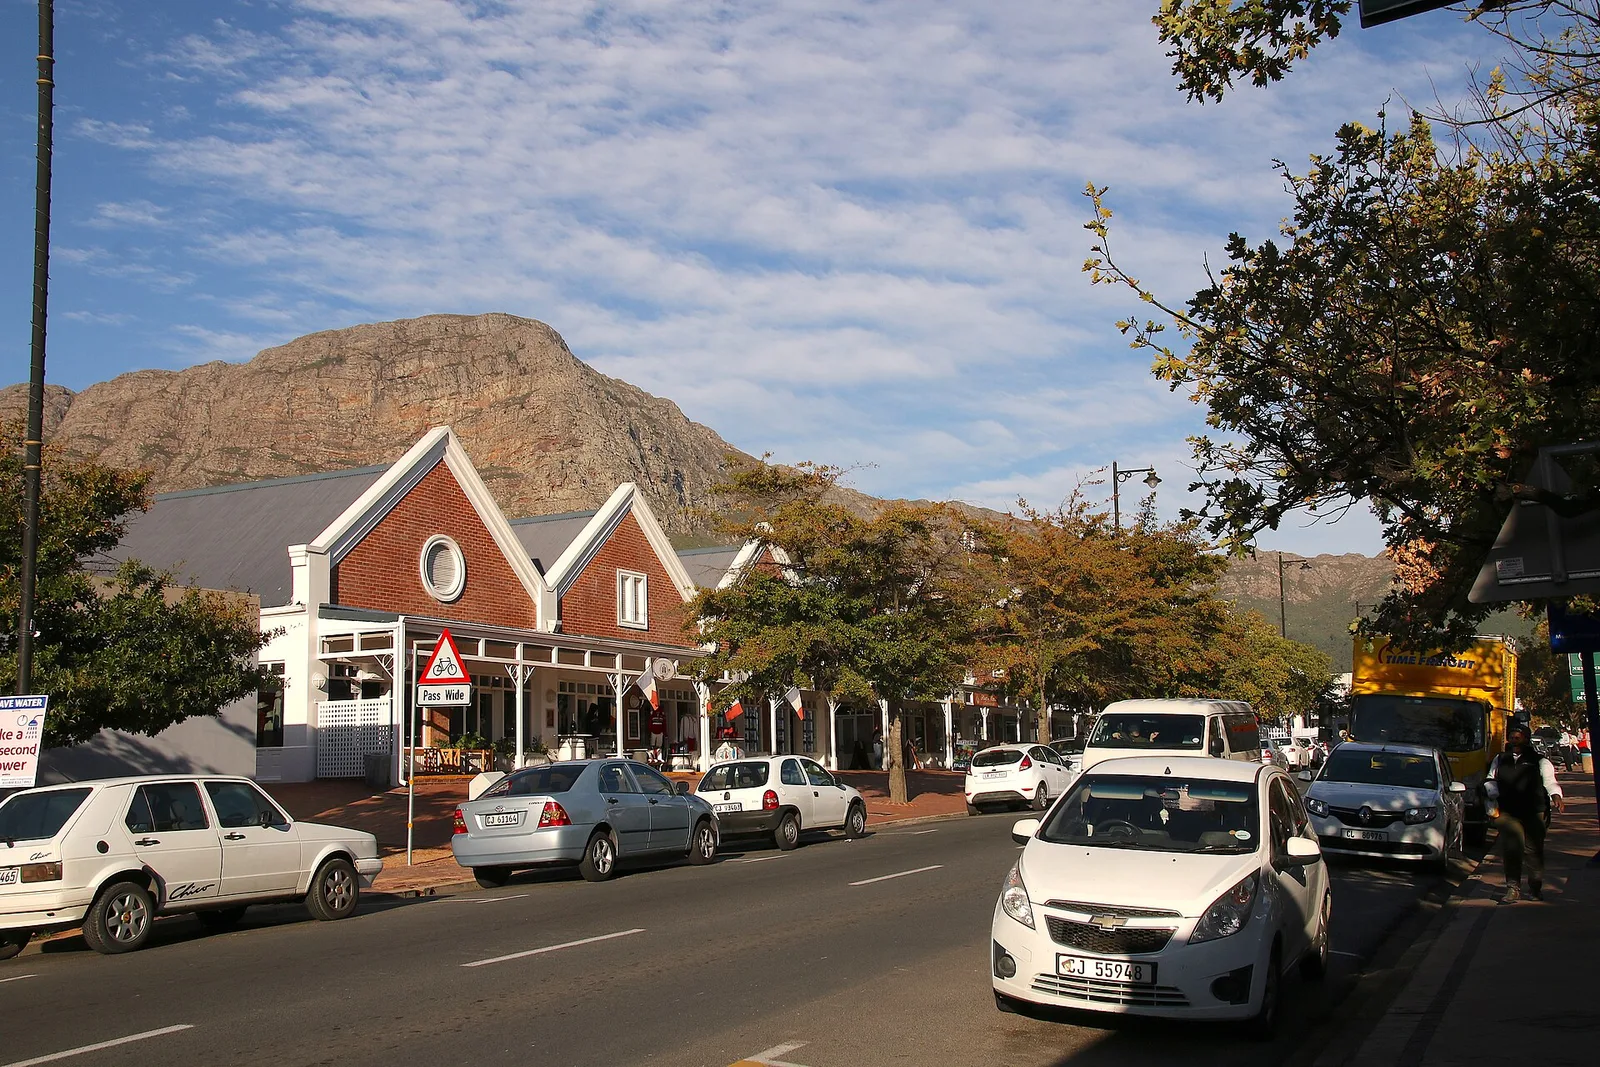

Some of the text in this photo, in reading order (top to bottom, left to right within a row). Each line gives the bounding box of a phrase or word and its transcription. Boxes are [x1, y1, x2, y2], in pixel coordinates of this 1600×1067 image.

[1386, 655, 1417, 665] TIME
[423, 690, 464, 701] Pass Wide
[15, 698, 42, 707] WATER
[16, 730, 23, 740] a
[0, 761, 27, 771] wer
[0, 871, 16, 882] 465
[169, 883, 215, 900] Chico
[1066, 959, 1142, 981] CJ 55948
